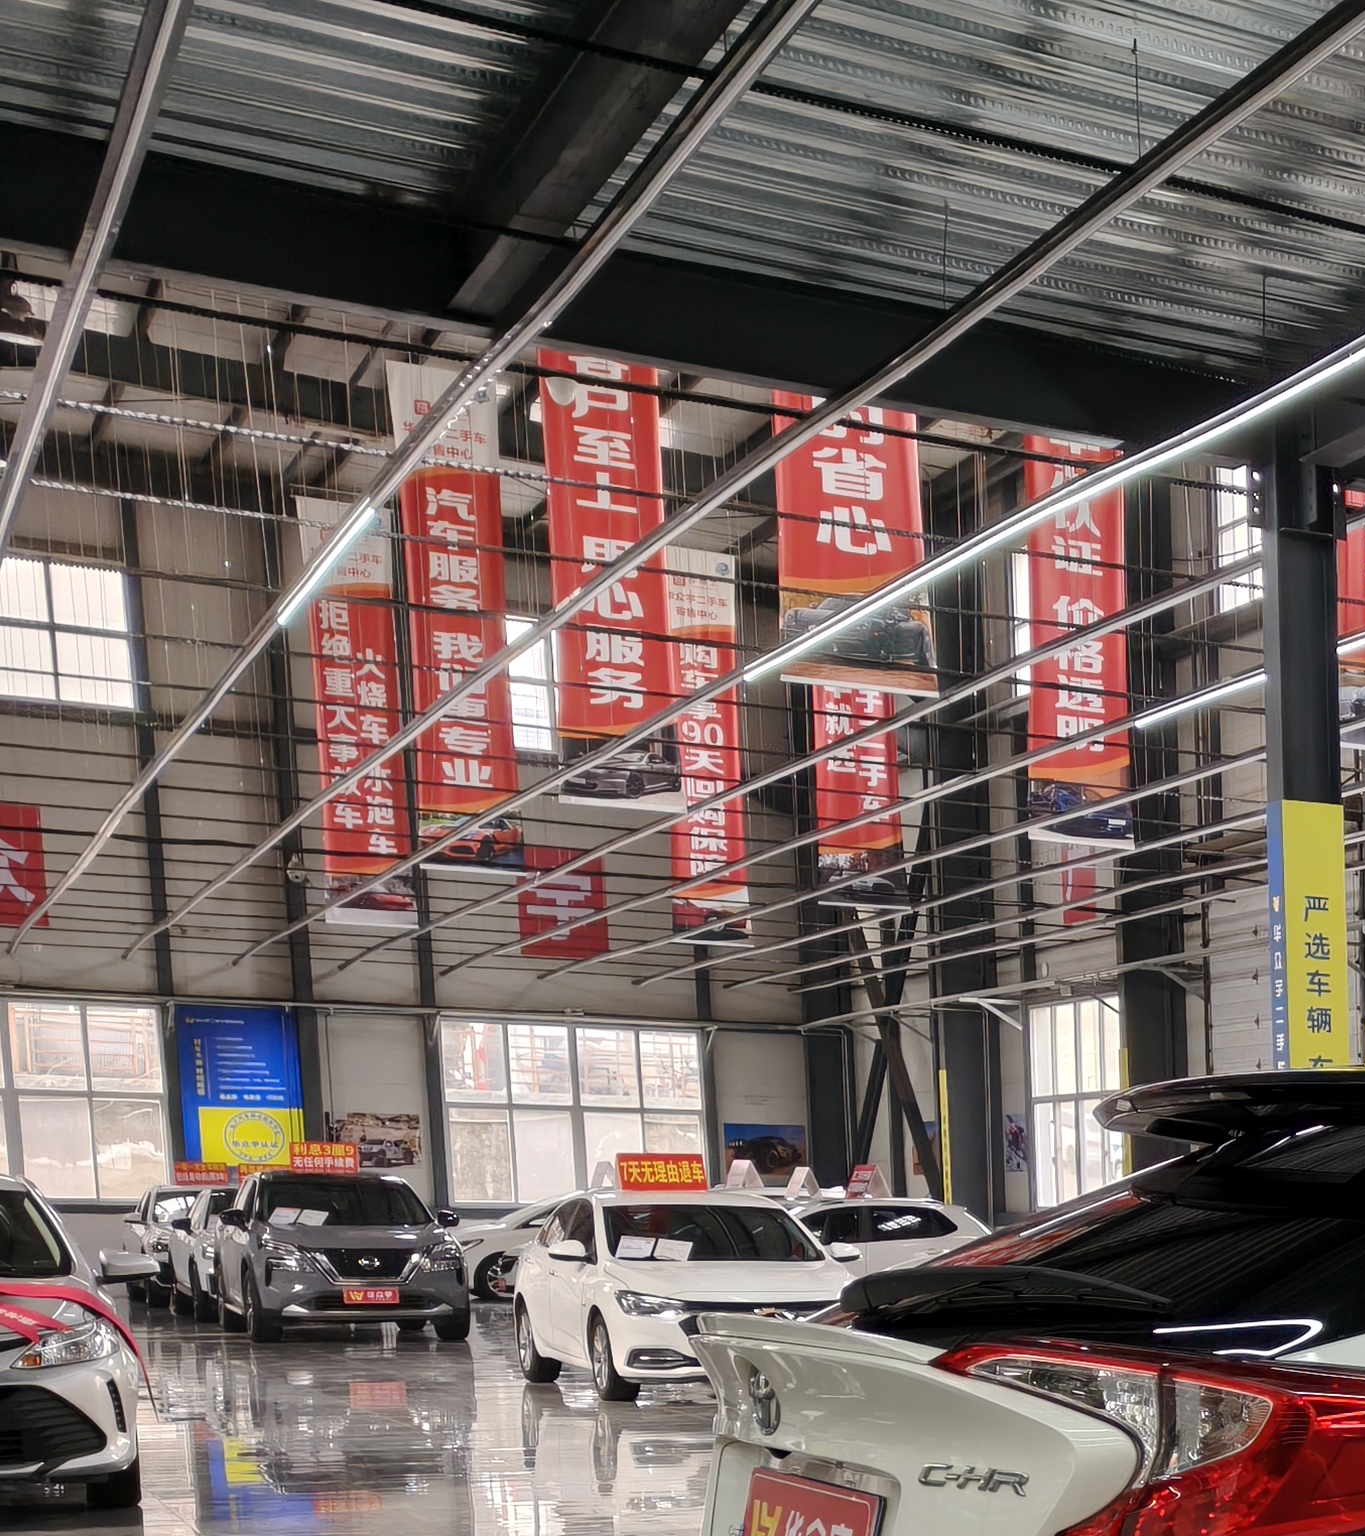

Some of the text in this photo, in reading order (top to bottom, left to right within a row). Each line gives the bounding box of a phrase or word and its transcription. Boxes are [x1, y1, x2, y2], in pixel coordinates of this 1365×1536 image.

[425, 486, 481, 612] 汽车服务
[1304, 895, 1332, 1034] 严选车辆
[620, 1161, 704, 1183] 7天无理由退车
[918, 1463, 1029, 1497] C-HR
